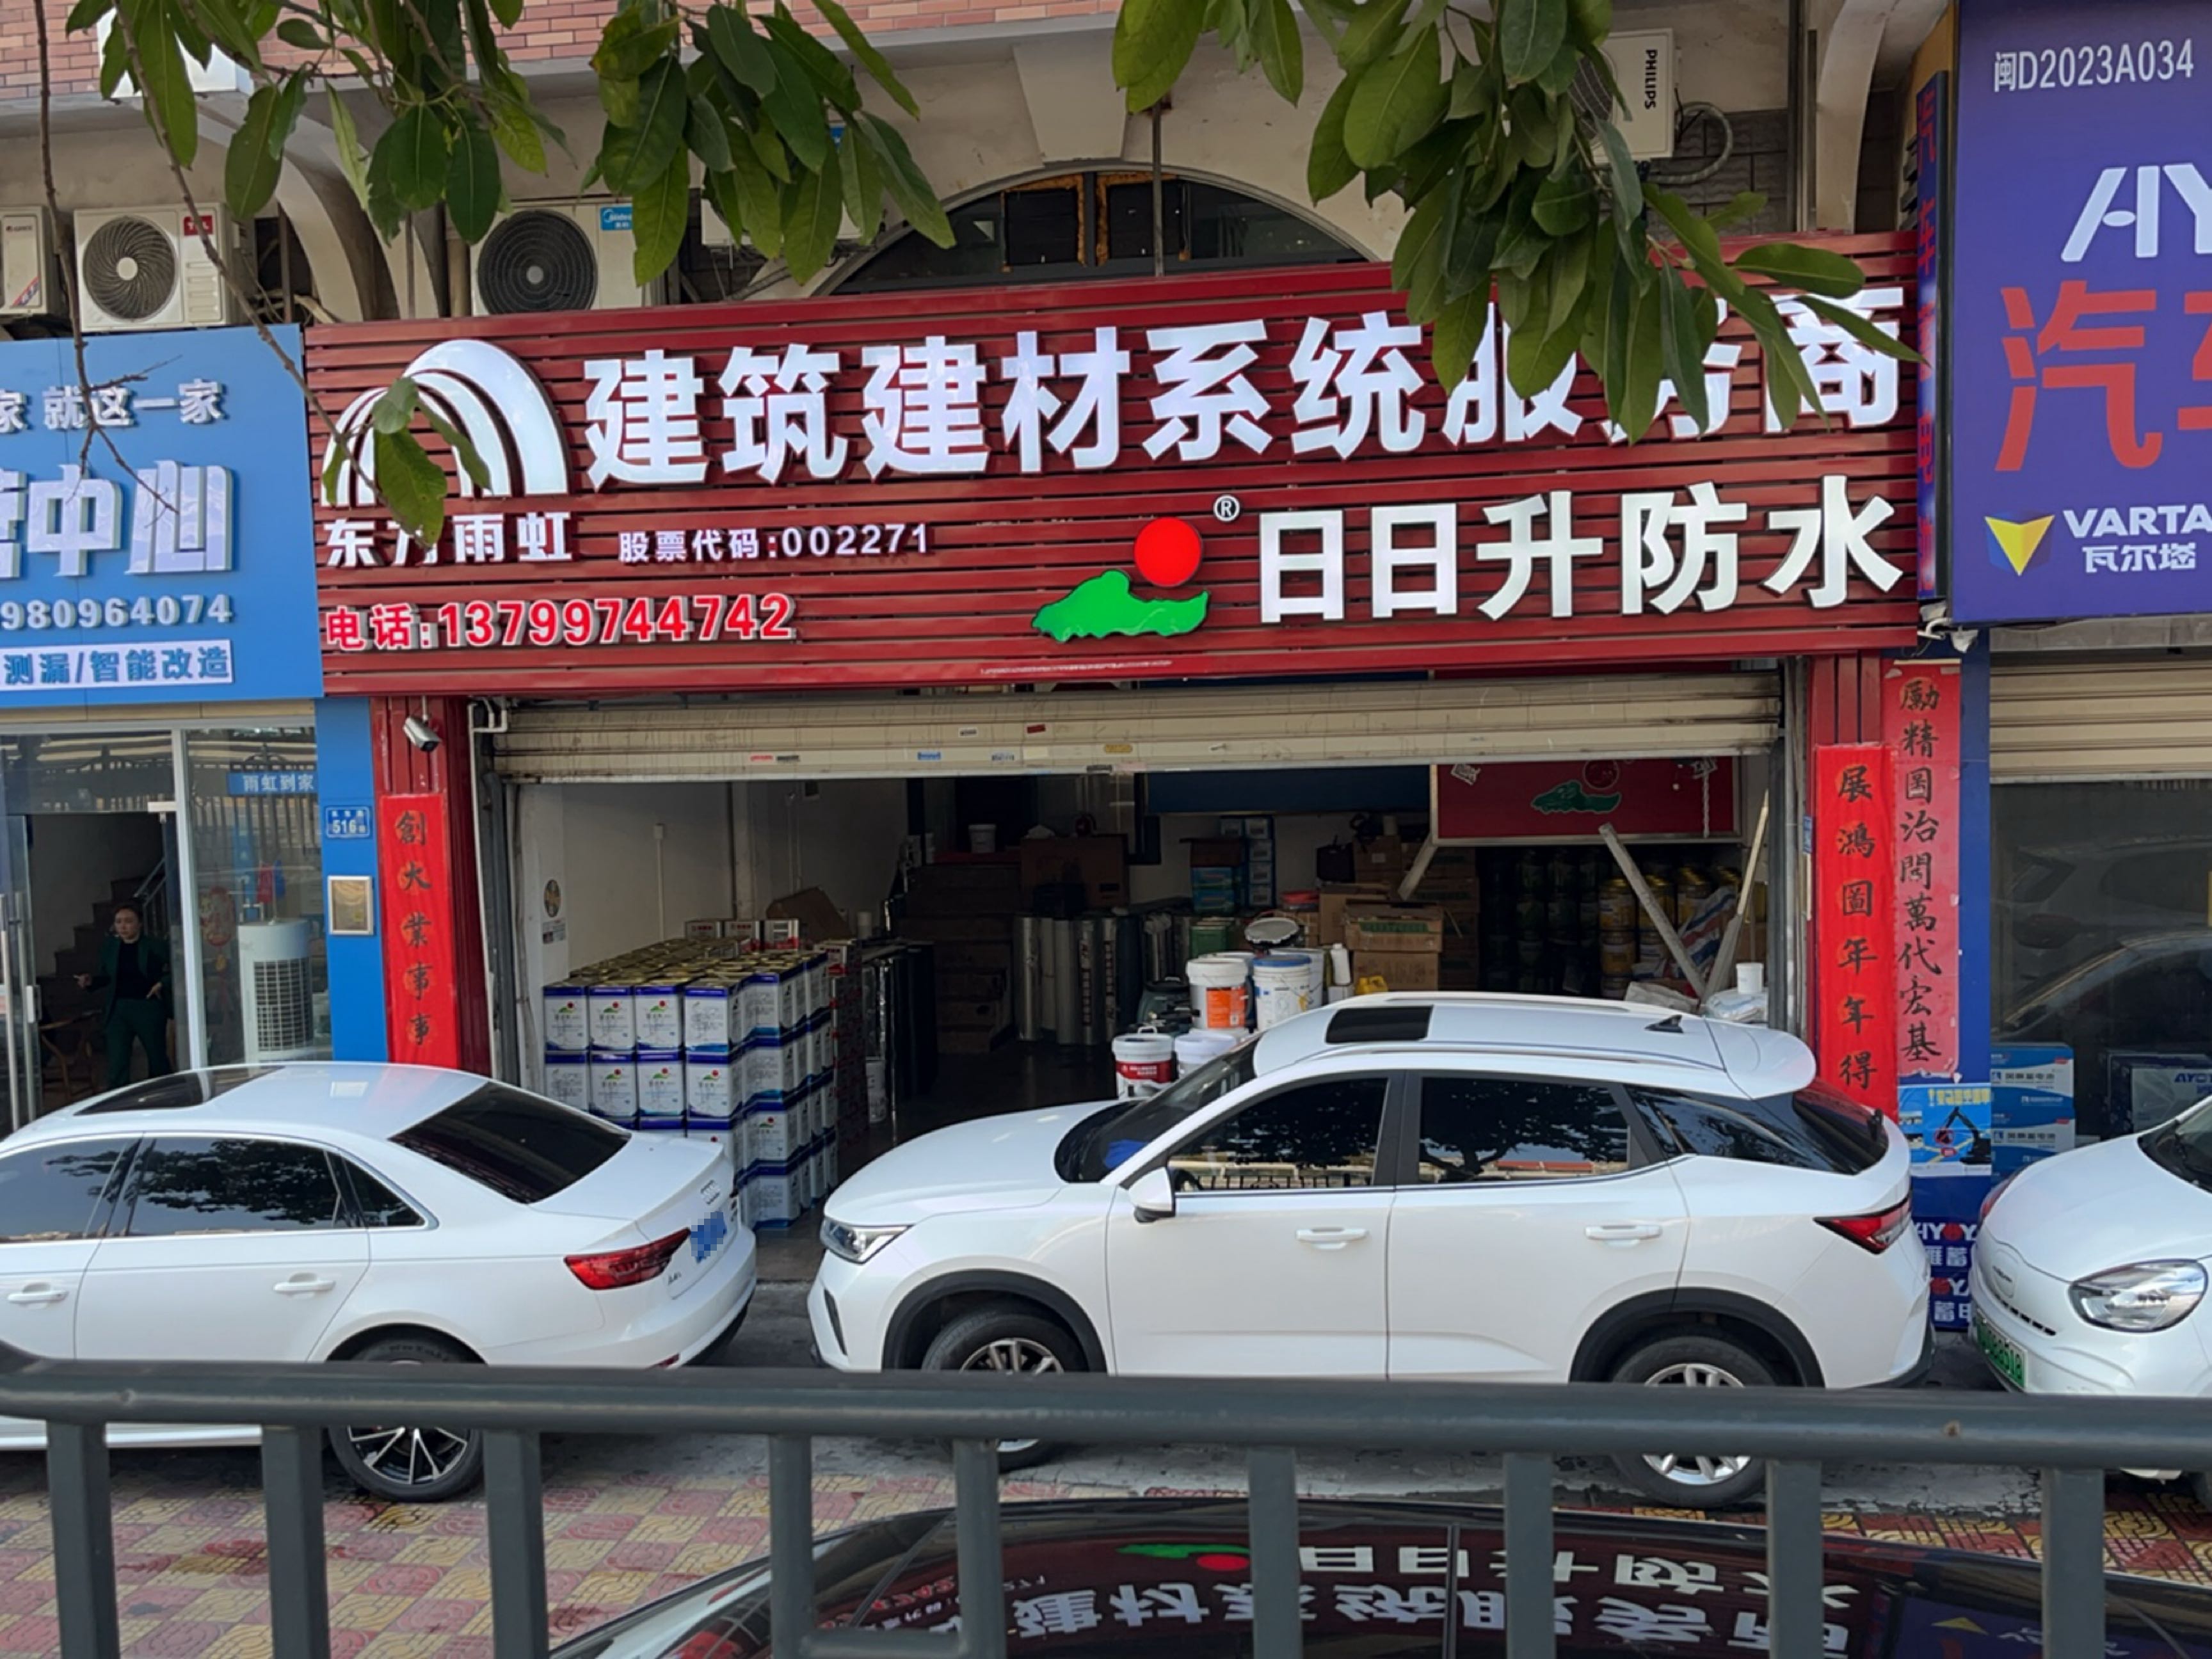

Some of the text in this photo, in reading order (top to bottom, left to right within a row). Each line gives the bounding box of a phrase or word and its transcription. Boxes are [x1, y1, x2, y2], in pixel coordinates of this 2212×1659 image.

[1644, 49, 1658, 110] PHILIPS
[1993, 38, 2195, 92] 闽D2023A034
[1994, 280, 2212, 471] 汽
[43, 378, 227, 431] 就这一家
[0, 460, 234, 579] 中心
[618, 524, 929, 565] 股票代码:002271
[2062, 503, 2212, 538] VARTA
[1260, 474, 1903, 623] 日日升防水
[2081, 542, 2196, 573] 瓦尔塔
[1, 594, 233, 630] 980964074
[325, 593, 796, 651] 电话:13799744742
[3, 646, 230, 685] 测漏/智能改造
